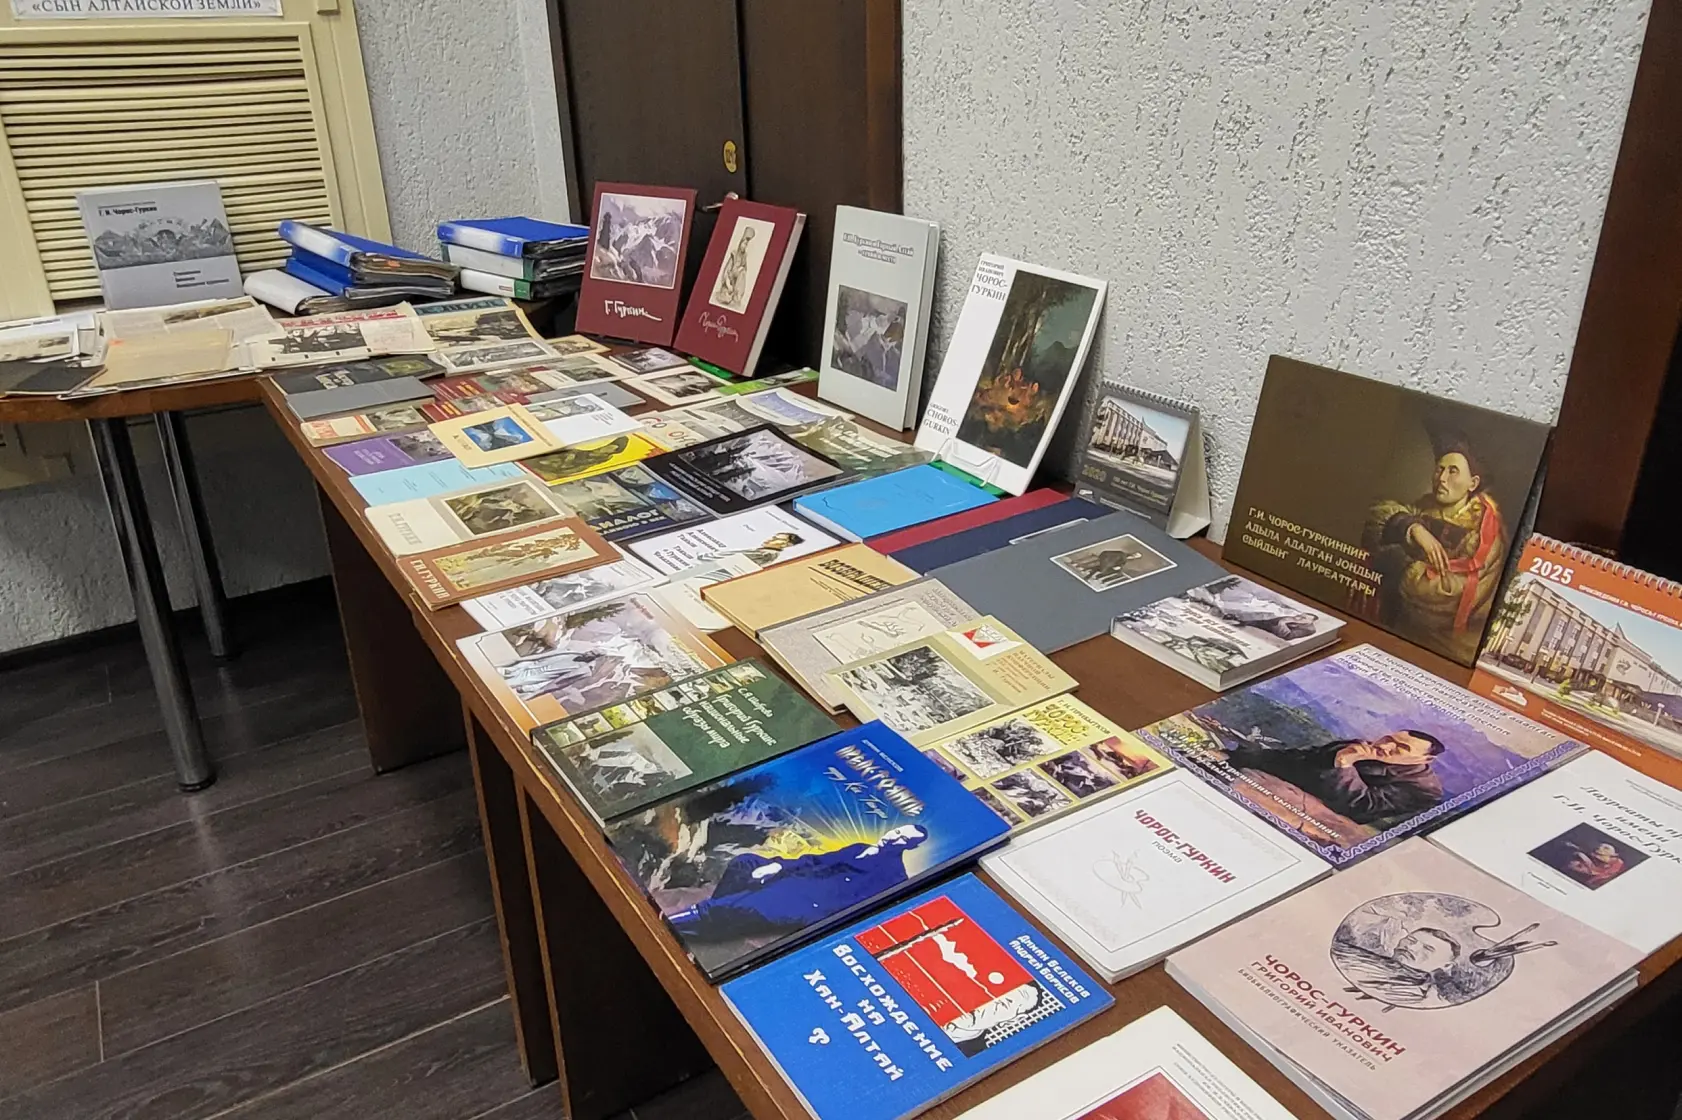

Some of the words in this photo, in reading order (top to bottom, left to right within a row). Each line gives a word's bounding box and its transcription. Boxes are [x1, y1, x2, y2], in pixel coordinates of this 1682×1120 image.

[971, 284, 1006, 301] ГУРКИН
[976, 272, 1008, 288] ЧОРОС-
[923, 418, 950, 436] GURKIN
[927, 409, 959, 427] CHOROS-
[1245, 521, 1281, 543] АДЫЛА
[1284, 537, 1334, 565] АДАЛГАН
[1297, 556, 1377, 598] ЛАУРЕАТТАРЫ
[1529, 556, 1575, 586] 2025
[1552, 793, 1587, 814] Г.И.
[1579, 785, 1665, 829] Лауреаты
[1133, 808, 1237, 884] ЧОРОС-ГУРКИН
[1614, 815, 1670, 843] имени
[1151, 840, 1183, 864] поэма
[832, 943, 954, 1073] ВОСХОЖДЕНИЕ
[856, 998, 887, 1026] НА
[1237, 967, 1331, 1039] БИОБИБЛИОГРАФИЧЕСКИЙ
[1331, 1036, 1378, 1072] УКАЗАТЕЛЬ
[1250, 960, 1317, 1011] ГРИГОРИЙ
[1315, 1009, 1393, 1063] ИВАНОВИЧ
[1264, 953, 1407, 1056] ЧОРОС-ГУРКИН
[802, 968, 906, 1082] ХАН-АЛТАЙ
